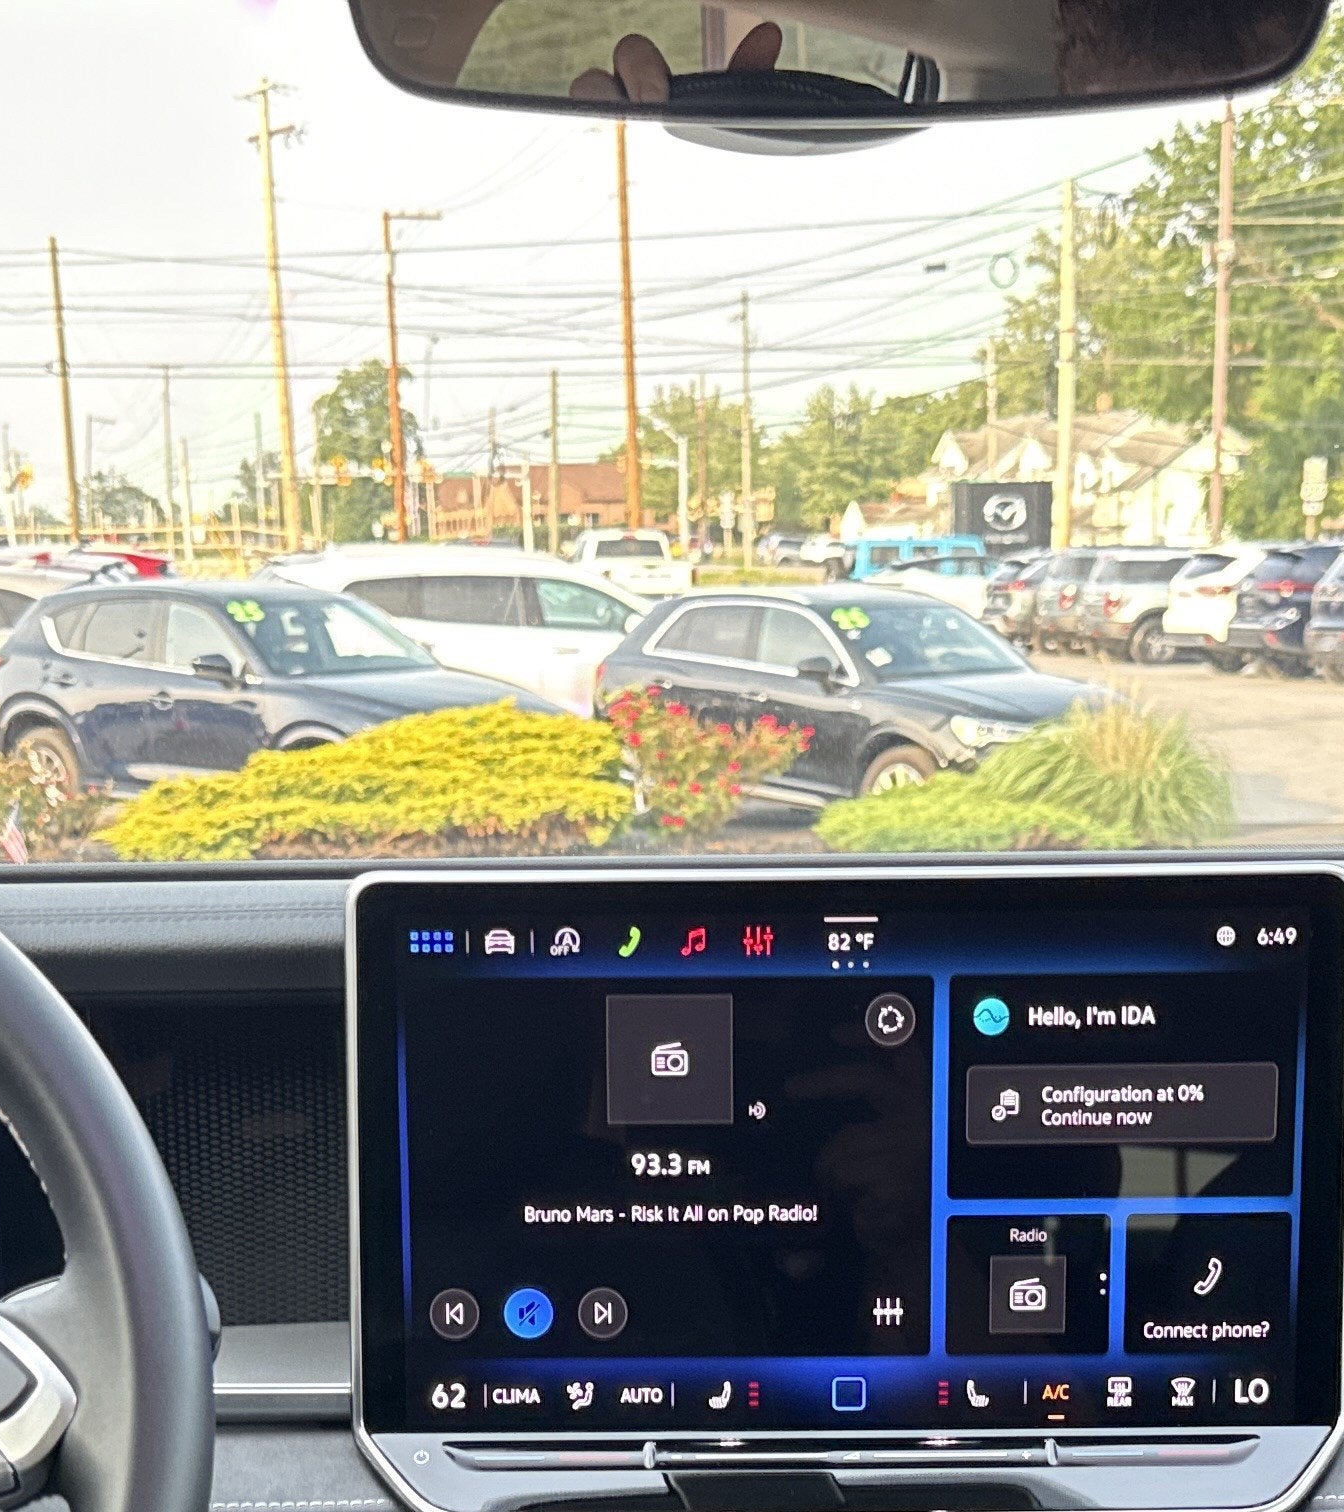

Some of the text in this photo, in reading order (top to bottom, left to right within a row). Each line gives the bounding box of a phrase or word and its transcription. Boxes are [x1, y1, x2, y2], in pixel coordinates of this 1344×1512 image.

[828, 934, 851, 950] 82
[1257, 927, 1297, 945] 6:49
[1028, 1006, 1156, 1029] Hello, I'm IDA
[1041, 1084, 1204, 1106] Configuration at 0%
[1041, 1109, 1152, 1126] Continue now
[631, 1153, 710, 1176] 93.3 FM
[524, 1206, 571, 1222] Bruno
[576, 1206, 614, 1222] Mars
[631, 1205, 663, 1222] Risk
[668, 1205, 679, 1222] It
[683, 1205, 703, 1222] All
[707, 1209, 728, 1222] on
[733, 1205, 764, 1225] Pop
[768, 1204, 818, 1222] Radio!
[1009, 1228, 1047, 1242] Radio
[1143, 1321, 1270, 1341] Connect phone?
[432, 1383, 465, 1409] 62
[492, 1388, 540, 1404] CLIMA
[620, 1387, 663, 1404] AUTO
[1042, 1384, 1070, 1401] A/C
[1235, 1378, 1269, 1404] LO
[1107, 1396, 1132, 1407] REAR
[1171, 1396, 1194, 1407] MAX
